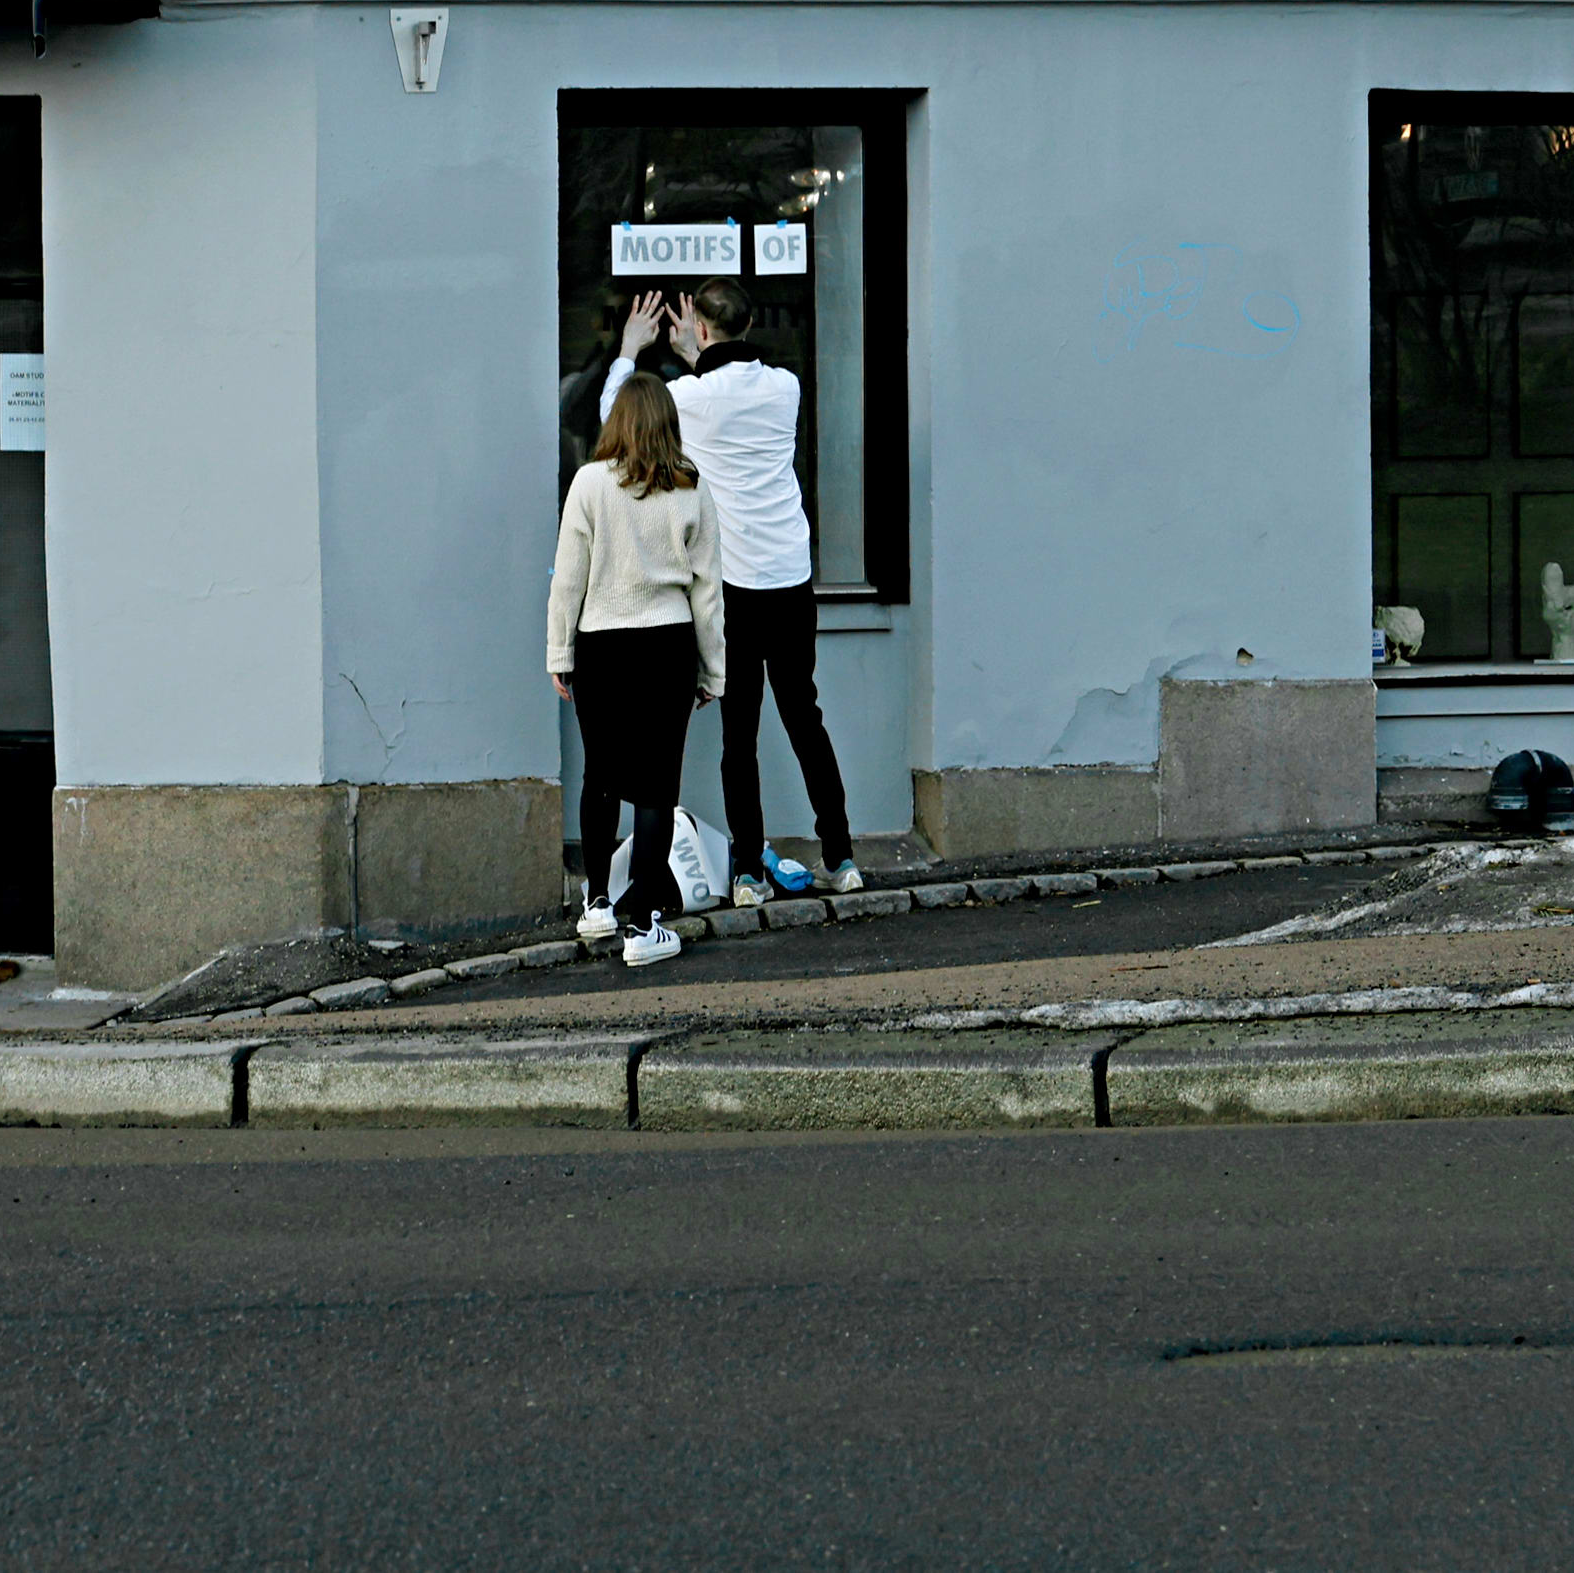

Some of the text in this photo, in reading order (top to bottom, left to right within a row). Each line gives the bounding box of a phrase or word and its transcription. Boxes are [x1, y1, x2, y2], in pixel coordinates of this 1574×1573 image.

[620, 236, 801, 262] MOTIFS OF
[673, 837, 711, 903] OAM
